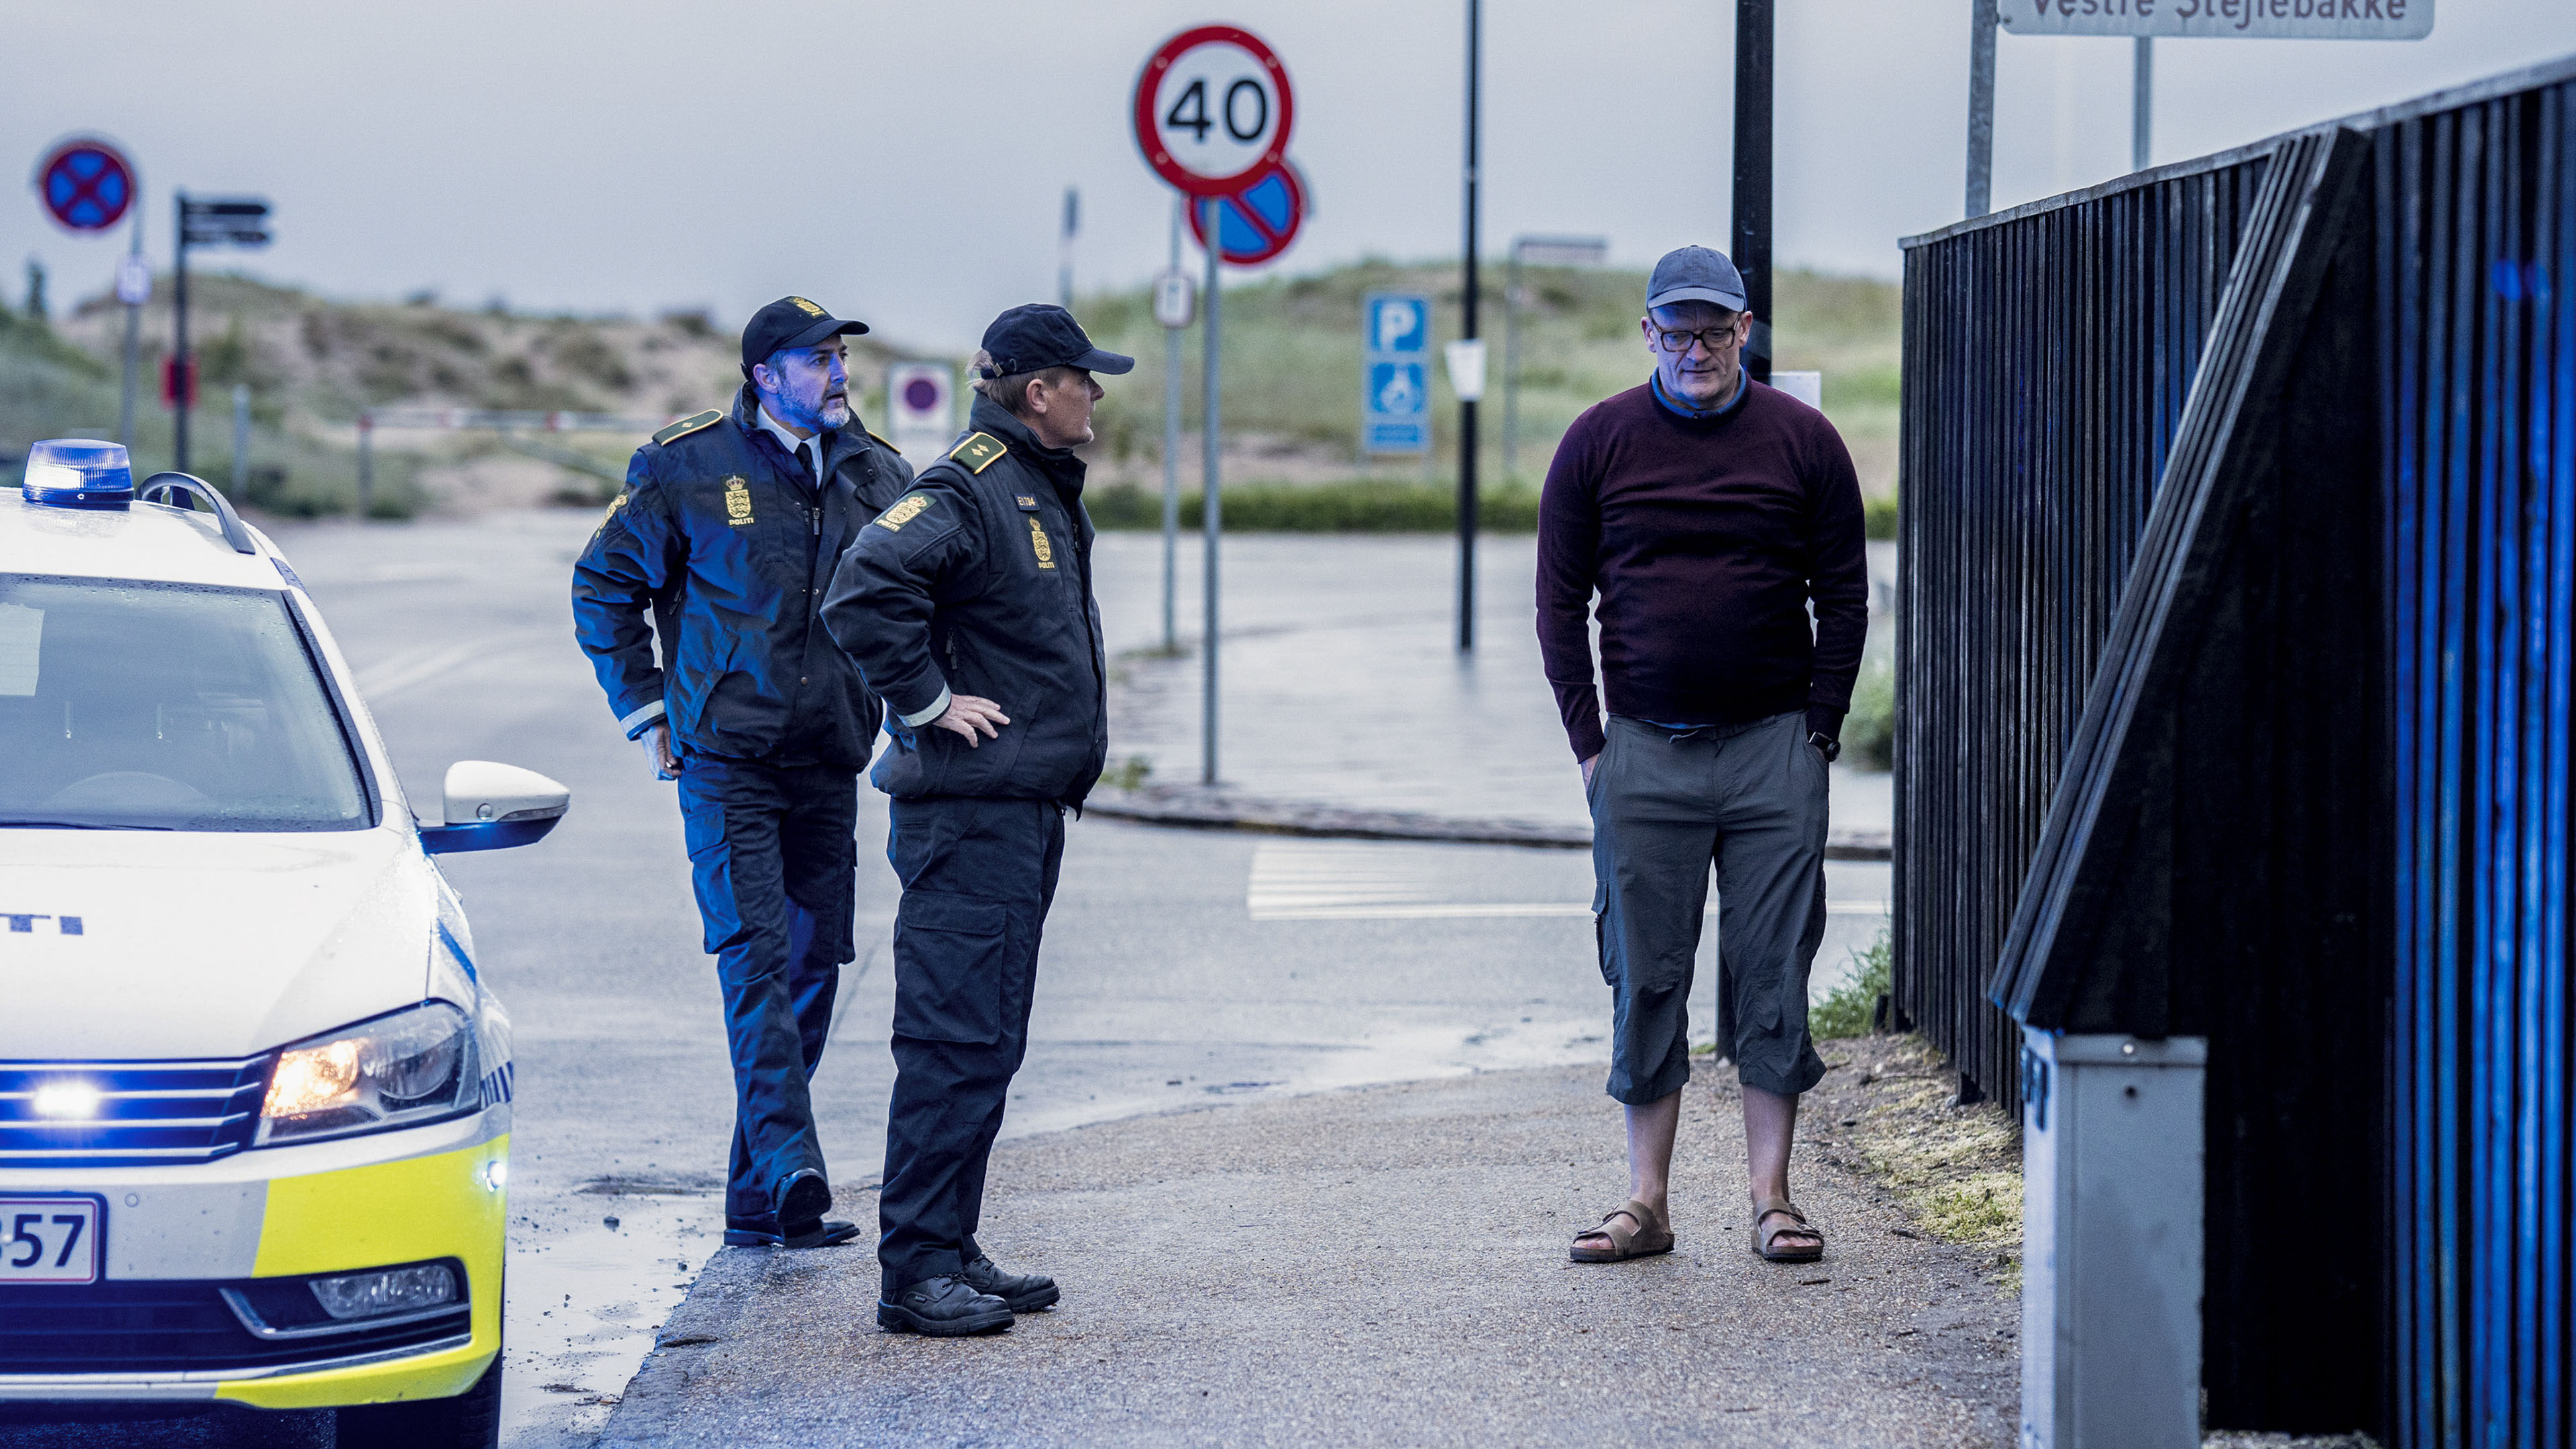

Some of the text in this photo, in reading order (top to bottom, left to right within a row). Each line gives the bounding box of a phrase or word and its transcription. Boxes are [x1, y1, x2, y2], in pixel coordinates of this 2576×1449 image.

[1167, 79, 1267, 141] 40
[1380, 303, 1417, 352] P
[729, 517, 754, 525] POLITI
[0, 1214, 85, 1267] 57
